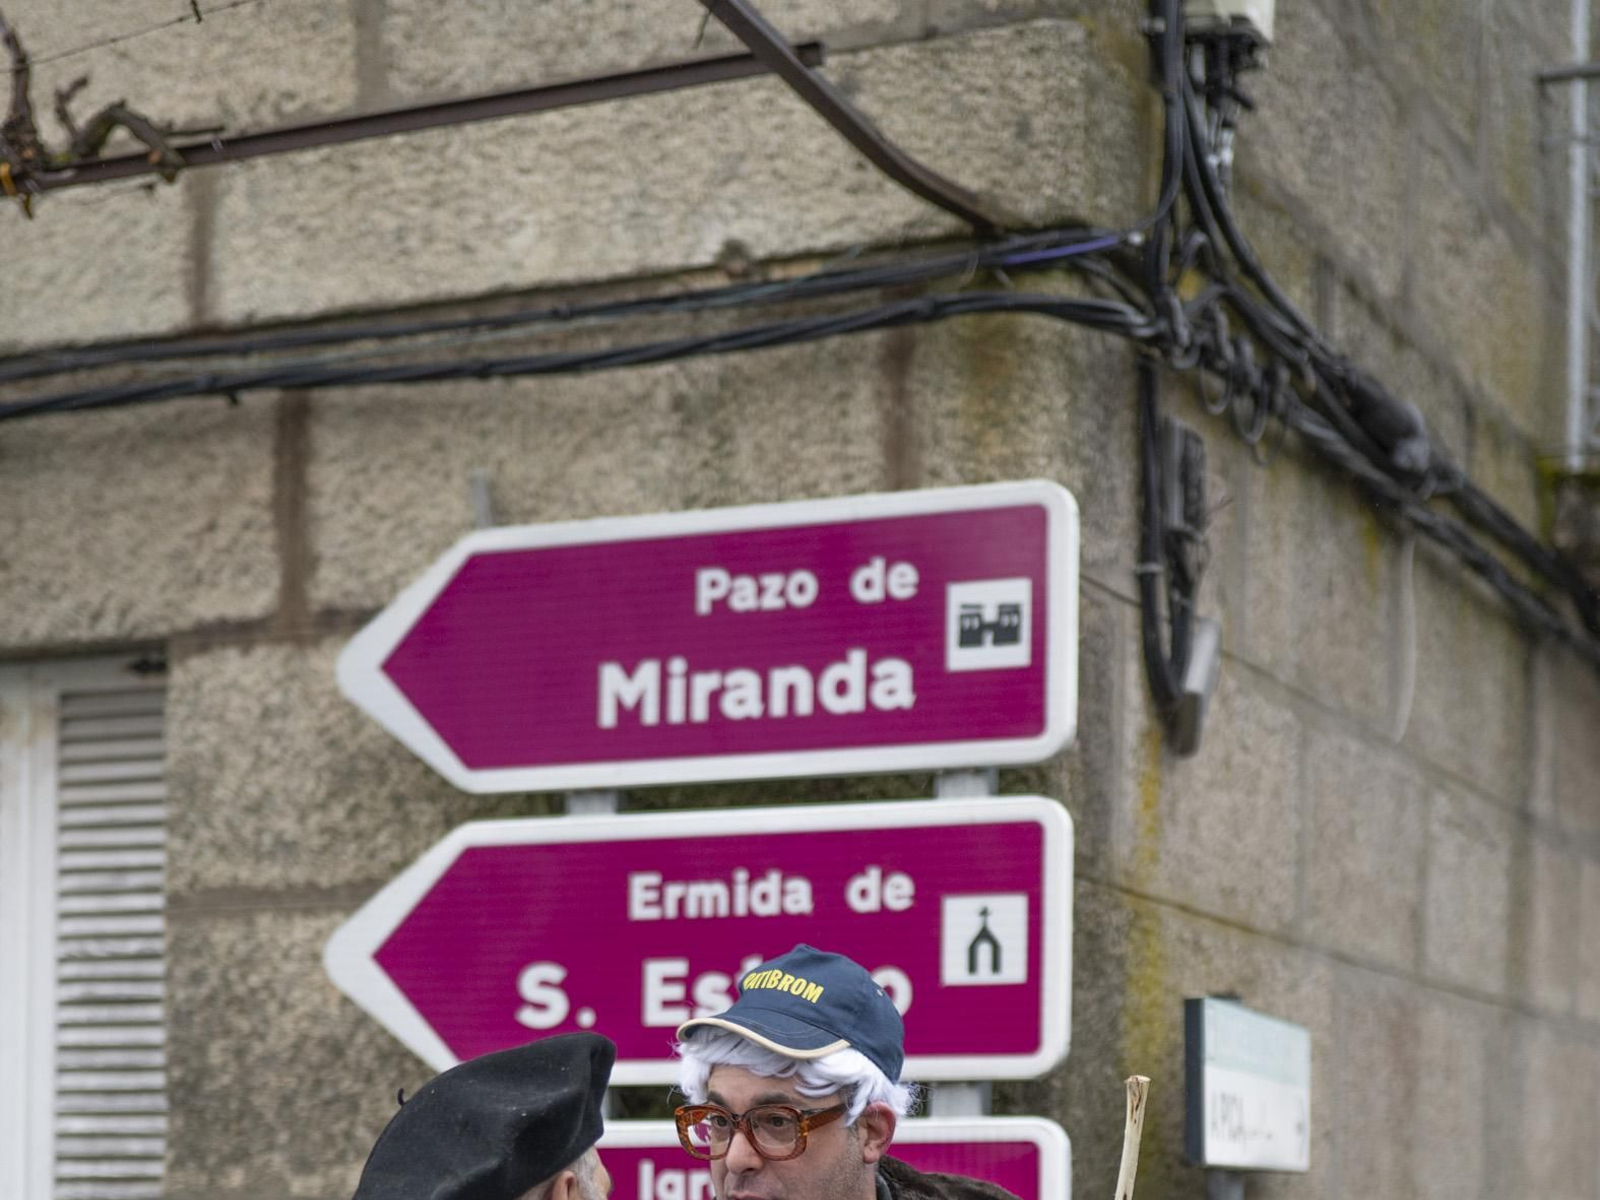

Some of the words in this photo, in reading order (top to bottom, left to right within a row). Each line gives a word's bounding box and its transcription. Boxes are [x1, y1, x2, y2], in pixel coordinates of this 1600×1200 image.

[695, 566, 819, 617] Pazo
[850, 555, 919, 603] de
[597, 648, 916, 730] Miranda
[628, 868, 814, 922] Ermida
[845, 866, 915, 913] de
[515, 961, 597, 1030] S.
